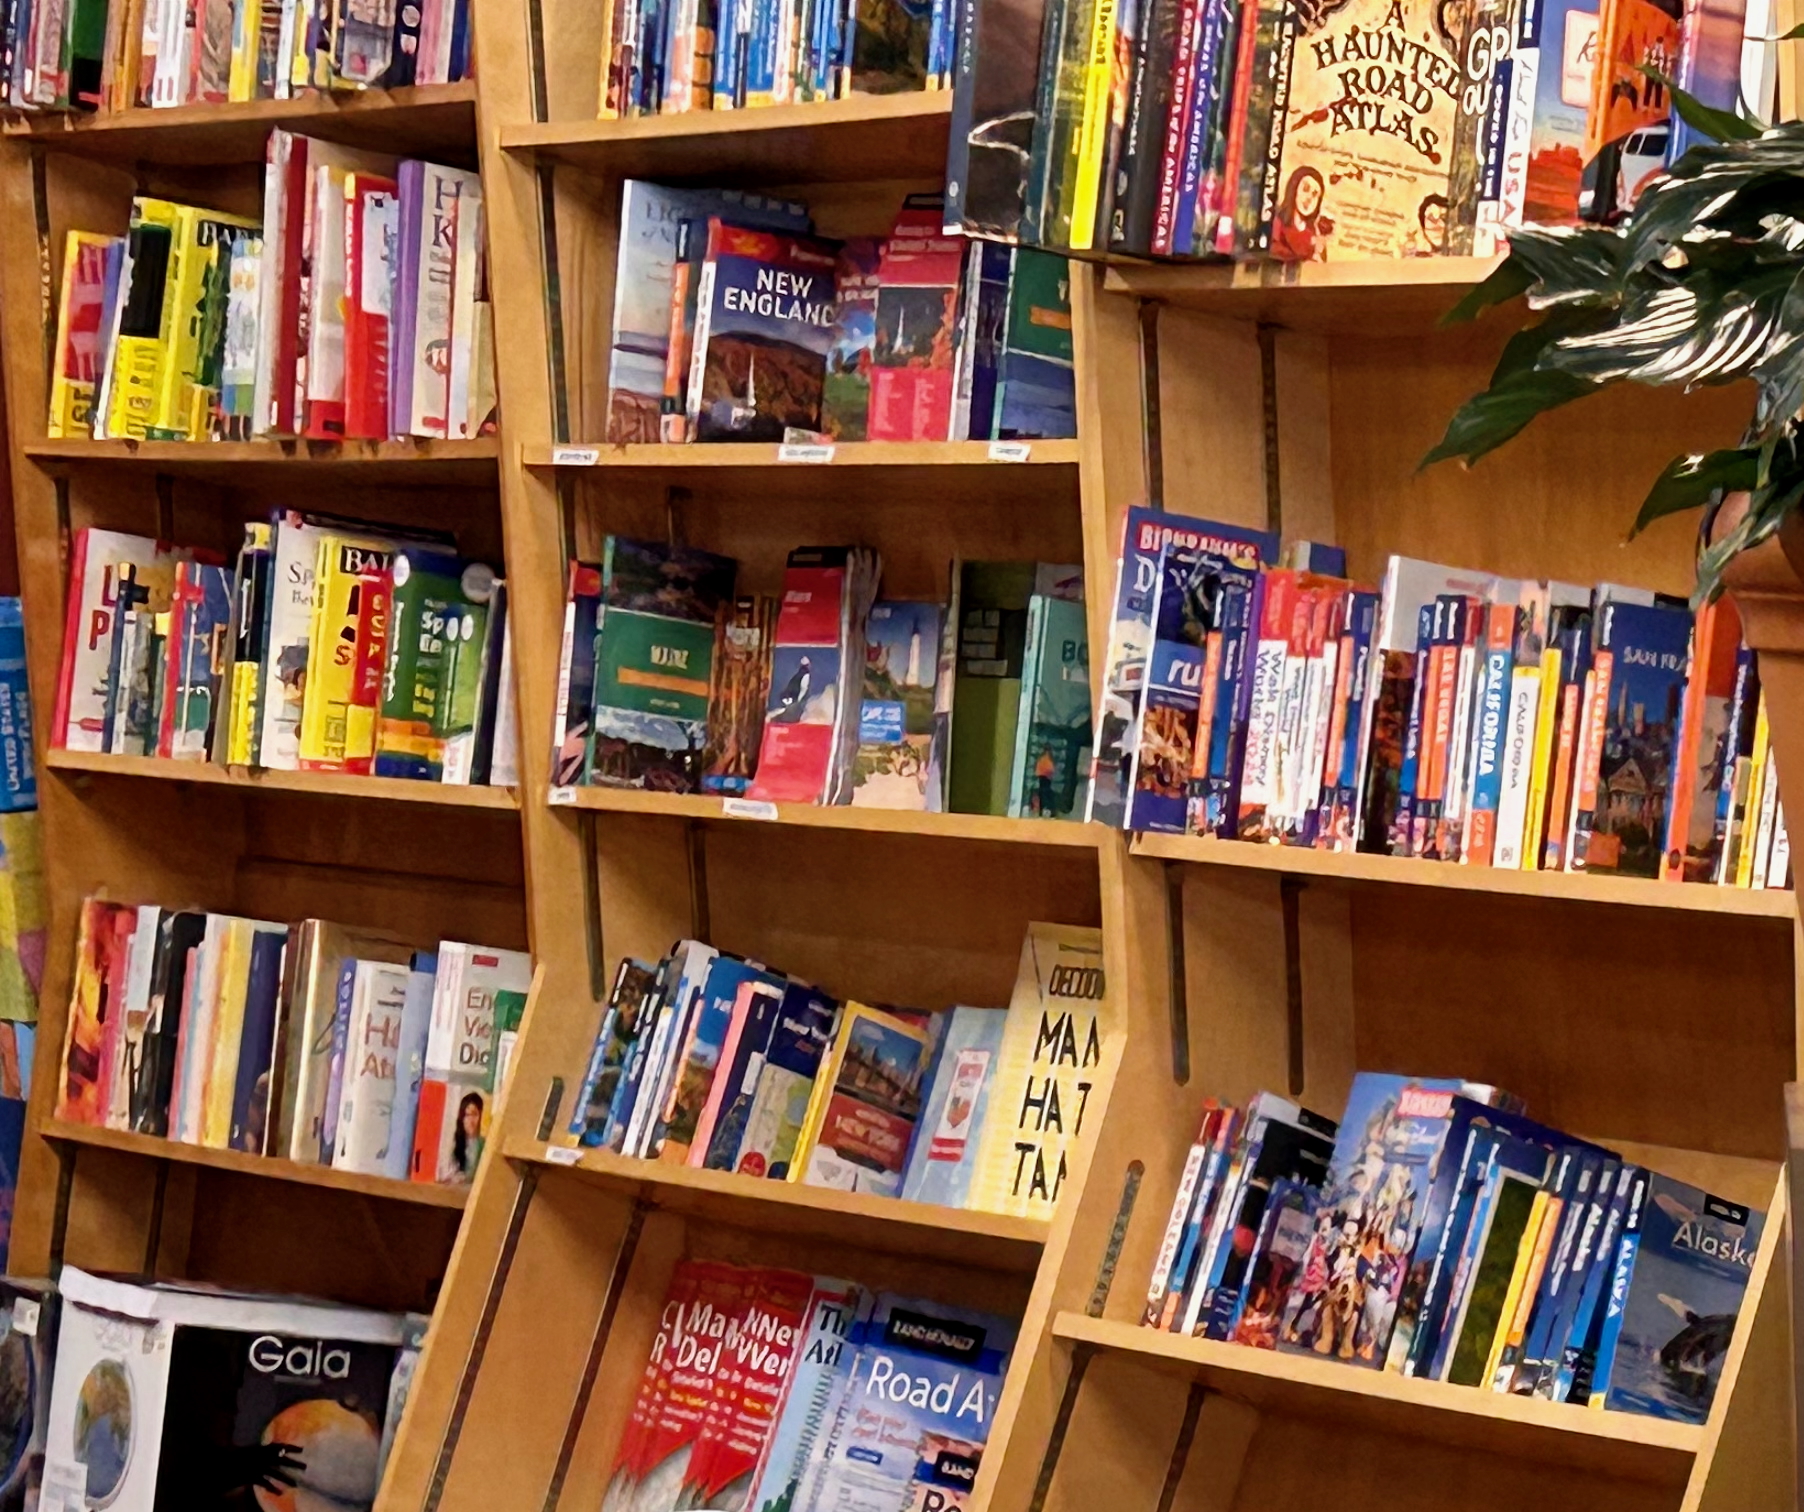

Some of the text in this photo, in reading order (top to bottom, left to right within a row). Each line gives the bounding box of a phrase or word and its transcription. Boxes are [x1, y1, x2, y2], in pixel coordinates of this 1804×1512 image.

[1338, 65, 1434, 114] ROAD
[1331, 101, 1441, 163] ATLAS
[724, 287, 836, 327] ENGLAND
[757, 269, 813, 298] NEW
[1479, 654, 1505, 776] CALIFORNIA
[866, 1355, 996, 1424] Road A
